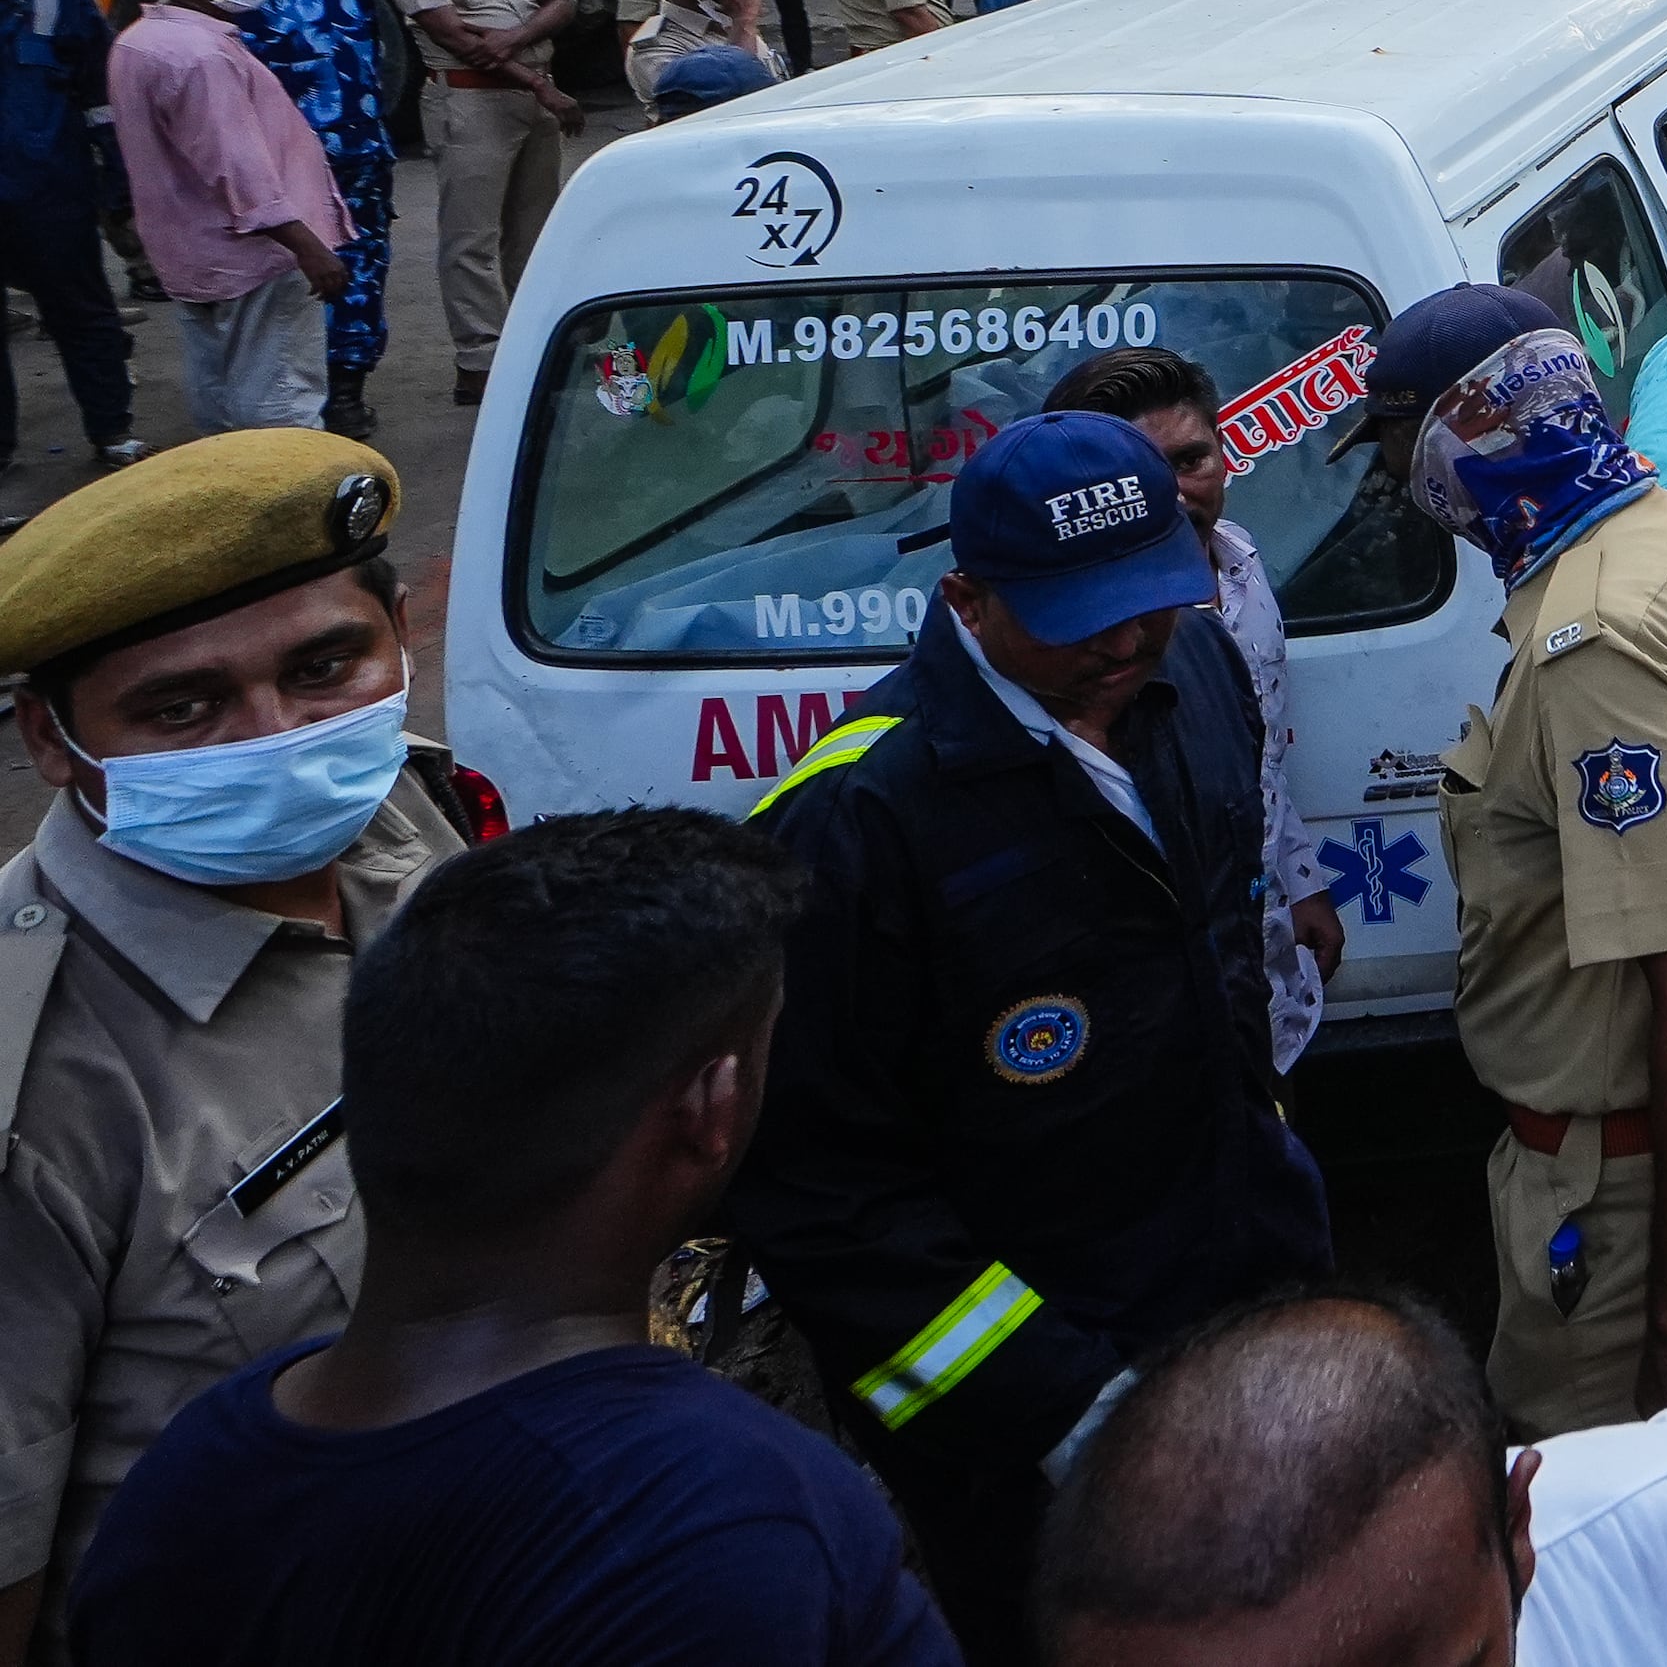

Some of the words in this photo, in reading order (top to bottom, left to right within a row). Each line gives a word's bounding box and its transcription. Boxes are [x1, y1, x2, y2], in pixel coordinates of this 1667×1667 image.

[731, 176, 789, 217] 24
[726, 302, 1158, 366] M.9825686400
[1217, 334, 1374, 477] પાલ
[1481, 351, 1592, 407] ourself
[1045, 475, 1144, 524] FIRE
[1055, 500, 1149, 541] RESCUE
[755, 587, 928, 639] M.990
[691, 690, 869, 783] AM
